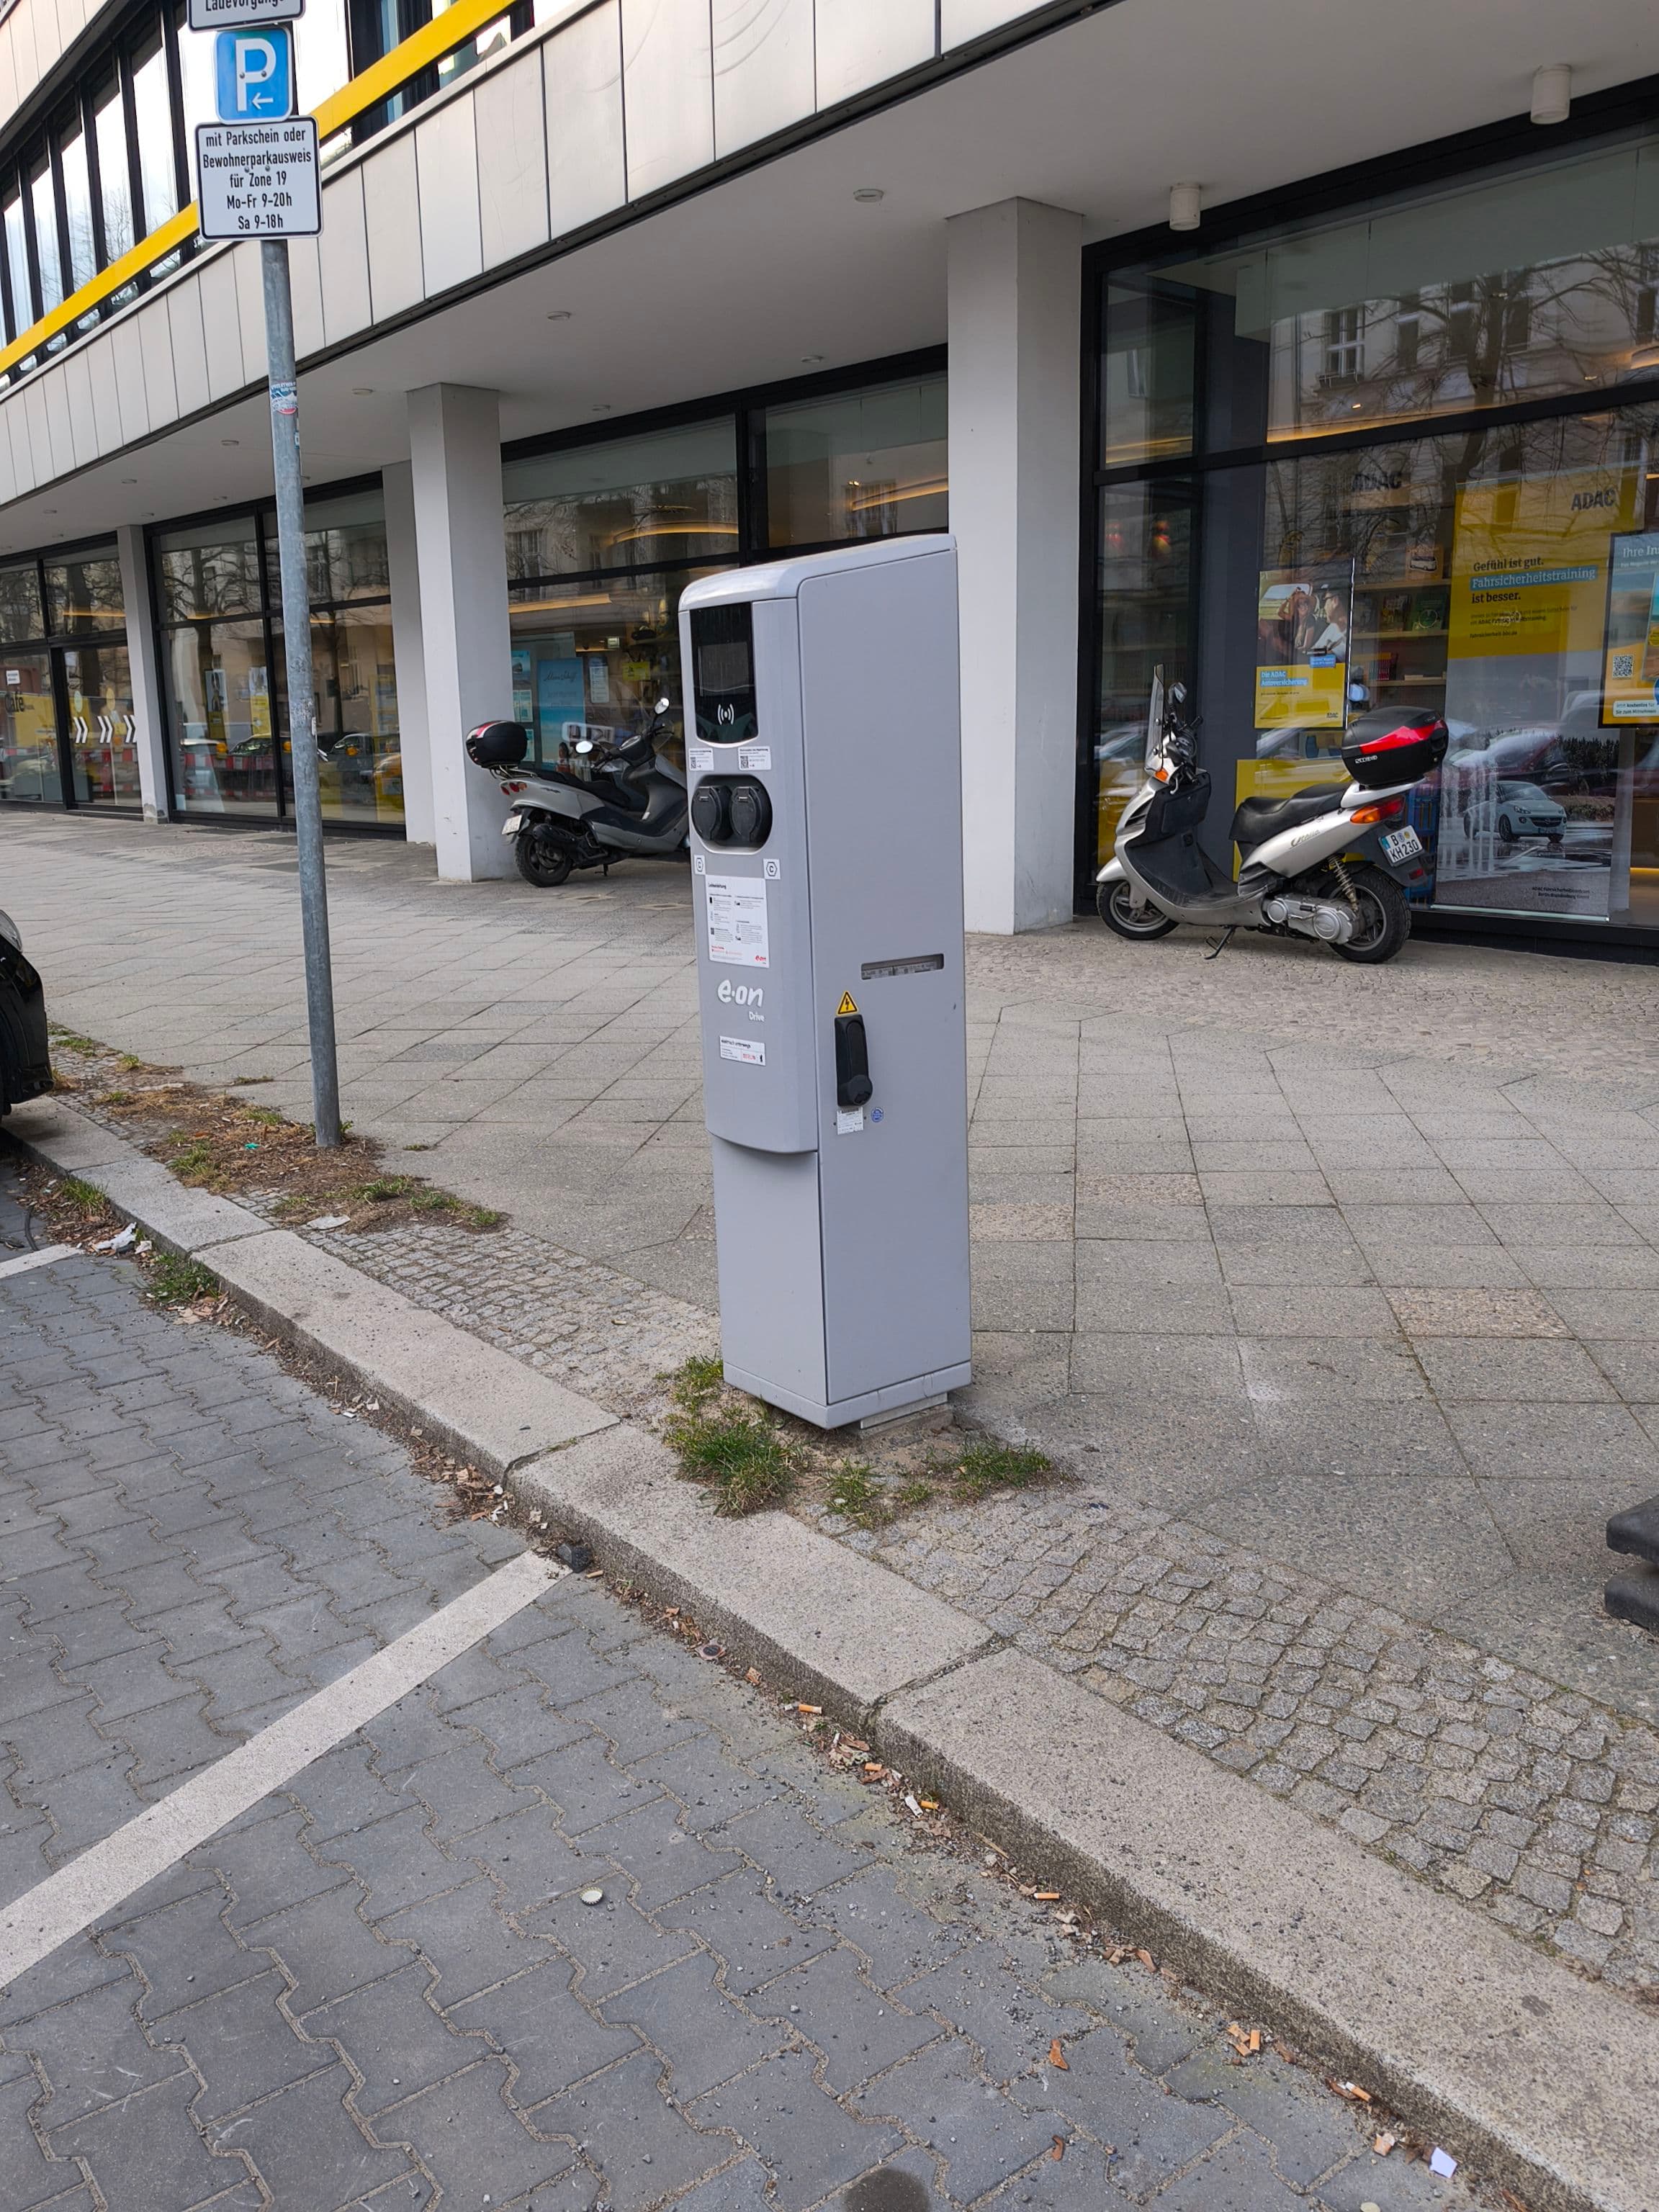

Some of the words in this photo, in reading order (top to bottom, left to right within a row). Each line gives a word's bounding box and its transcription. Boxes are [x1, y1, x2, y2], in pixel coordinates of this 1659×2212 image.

[235, 37, 277, 112] P
[206, 132, 222, 147] mit
[226, 128, 279, 145] Parkschein
[284, 127, 306, 142] oder
[202, 148, 312, 170] Bewohnerparkausweis
[230, 174, 244, 188] für
[248, 173, 271, 187] Zone
[276, 171, 287, 186] 19
[227, 194, 257, 210] Mo-Fr
[238, 215, 251, 230] Sa
[1571, 488, 1616, 511] ADAC
[1623, 547, 1644, 558] Ihre
[1473, 558, 1507, 572] Gefühl
[1509, 557, 1521, 569] ist
[1524, 556, 1544, 570] gut.
[1472, 568, 1596, 588] Fahrsicherheitstraining
[1471, 593, 1484, 603] ist
[1486, 592, 1521, 603] besser.
[1390, 835, 1399, 846] B
[749, 1010, 765, 1022] Drive
